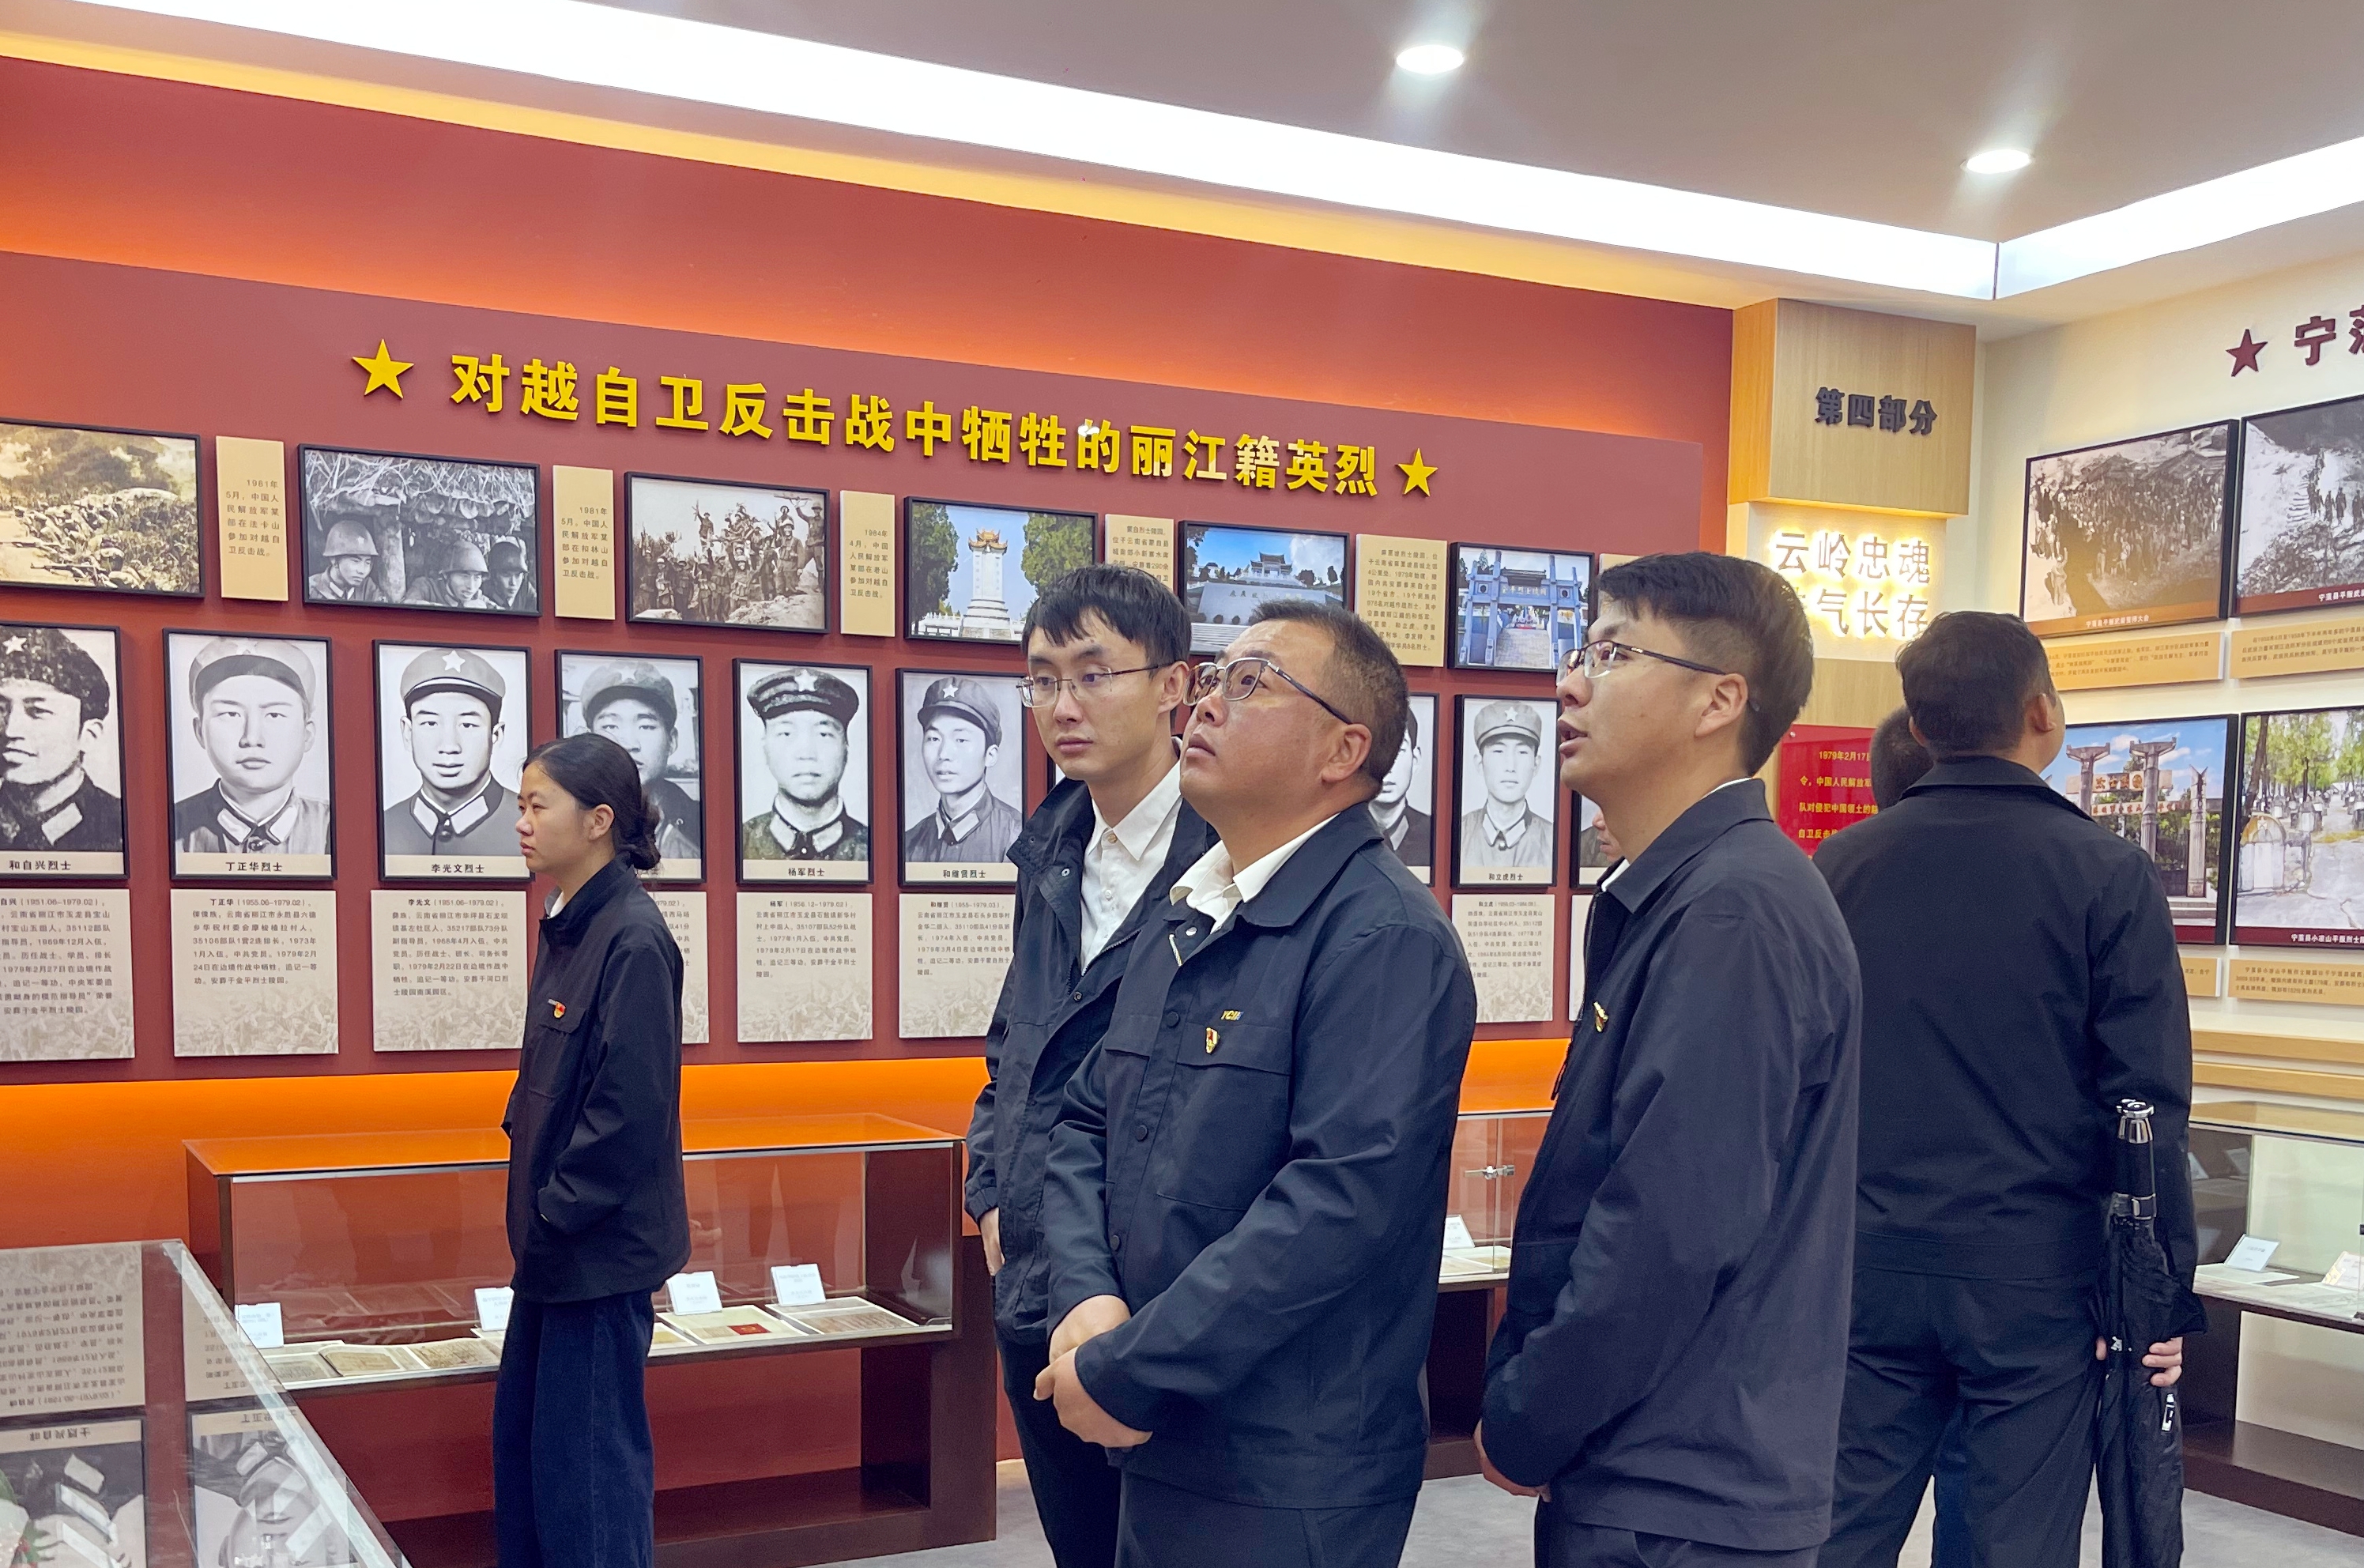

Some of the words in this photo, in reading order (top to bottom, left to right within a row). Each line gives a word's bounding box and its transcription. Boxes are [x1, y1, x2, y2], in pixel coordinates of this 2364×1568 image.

[1815, 386, 1938, 435] 第四部分
[451, 352, 1378, 497] 对越自卫反击战中牺牲的丽江籍英烈
[247, 479, 278, 488] 1981年
[579, 507, 607, 515] 1981年
[228, 532, 280, 544] 参加对越自
[228, 545, 270, 556] 卫反击战。
[562, 556, 608, 567] 参加对越自
[850, 552, 888, 562] 人民解放军
[1775, 532, 1930, 584] 云岭忠魂
[562, 569, 599, 579] 卫反击战。
[850, 577, 888, 586] 参加对越自
[1797, 586, 1929, 637] 气长存
[9, 859, 72, 872] 和自兴烈士
[225, 861, 283, 873] 丁正华烈士
[431, 864, 484, 873] 李光文烈士
[788, 868, 825, 876] 杨军烈士
[1488, 873, 1524, 881] 和立虎烈士
